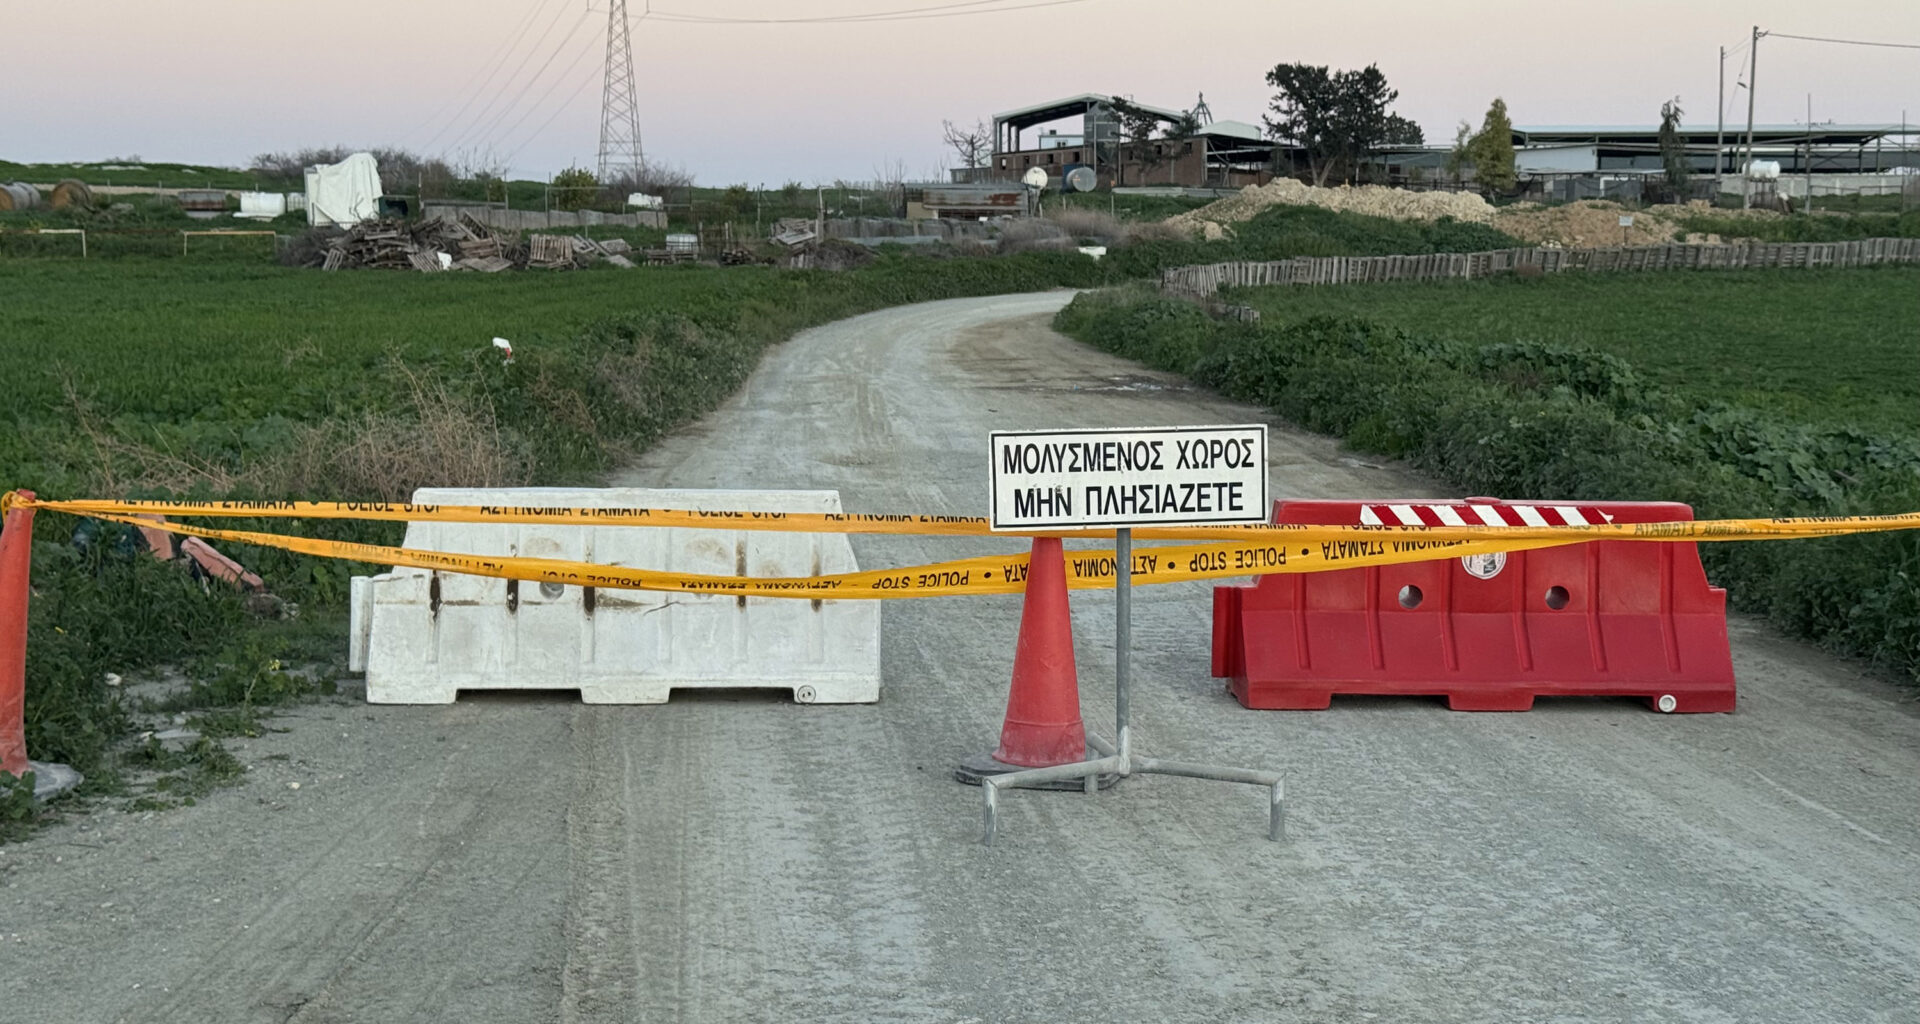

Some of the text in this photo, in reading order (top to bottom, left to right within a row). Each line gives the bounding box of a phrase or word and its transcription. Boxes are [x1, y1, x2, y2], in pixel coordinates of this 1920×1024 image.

[1003, 438, 1255, 474] ΜΟΛΥΣΜΕΝΟΣ ΧΩΡΟΣ
[1014, 482, 1243, 518] ΜΗΝ ΠΛΗΣΙΑΖΕΤΕ
[1189, 546, 1286, 572] POLICE STOP
[1321, 541, 1384, 561] ΣΤΑΜΑΤΑ
[1073, 555, 1158, 577] ΑΣΤΝΟΜΙΑ
[872, 570, 969, 589] POLICE STOP
